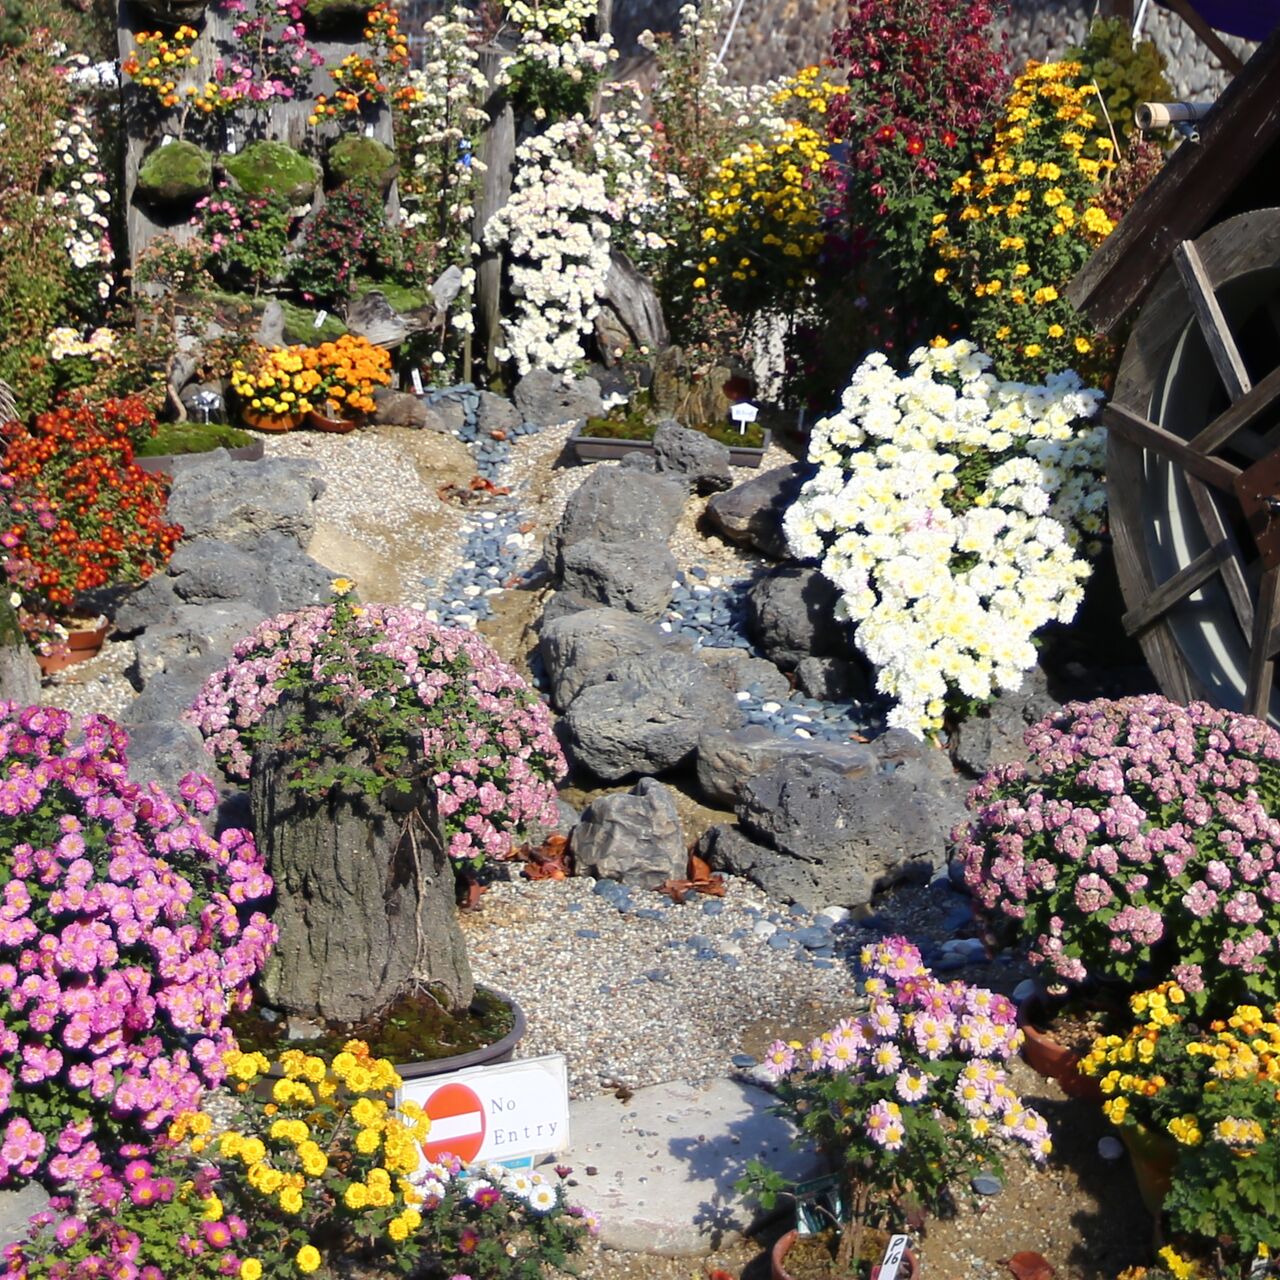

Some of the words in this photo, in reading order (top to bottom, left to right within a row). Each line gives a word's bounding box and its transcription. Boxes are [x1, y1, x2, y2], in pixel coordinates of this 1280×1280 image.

[491, 1098, 516, 1114] No
[493, 1122, 558, 1146] Entry
[890, 1237, 905, 1252] P
[884, 1251, 901, 1266] 16
